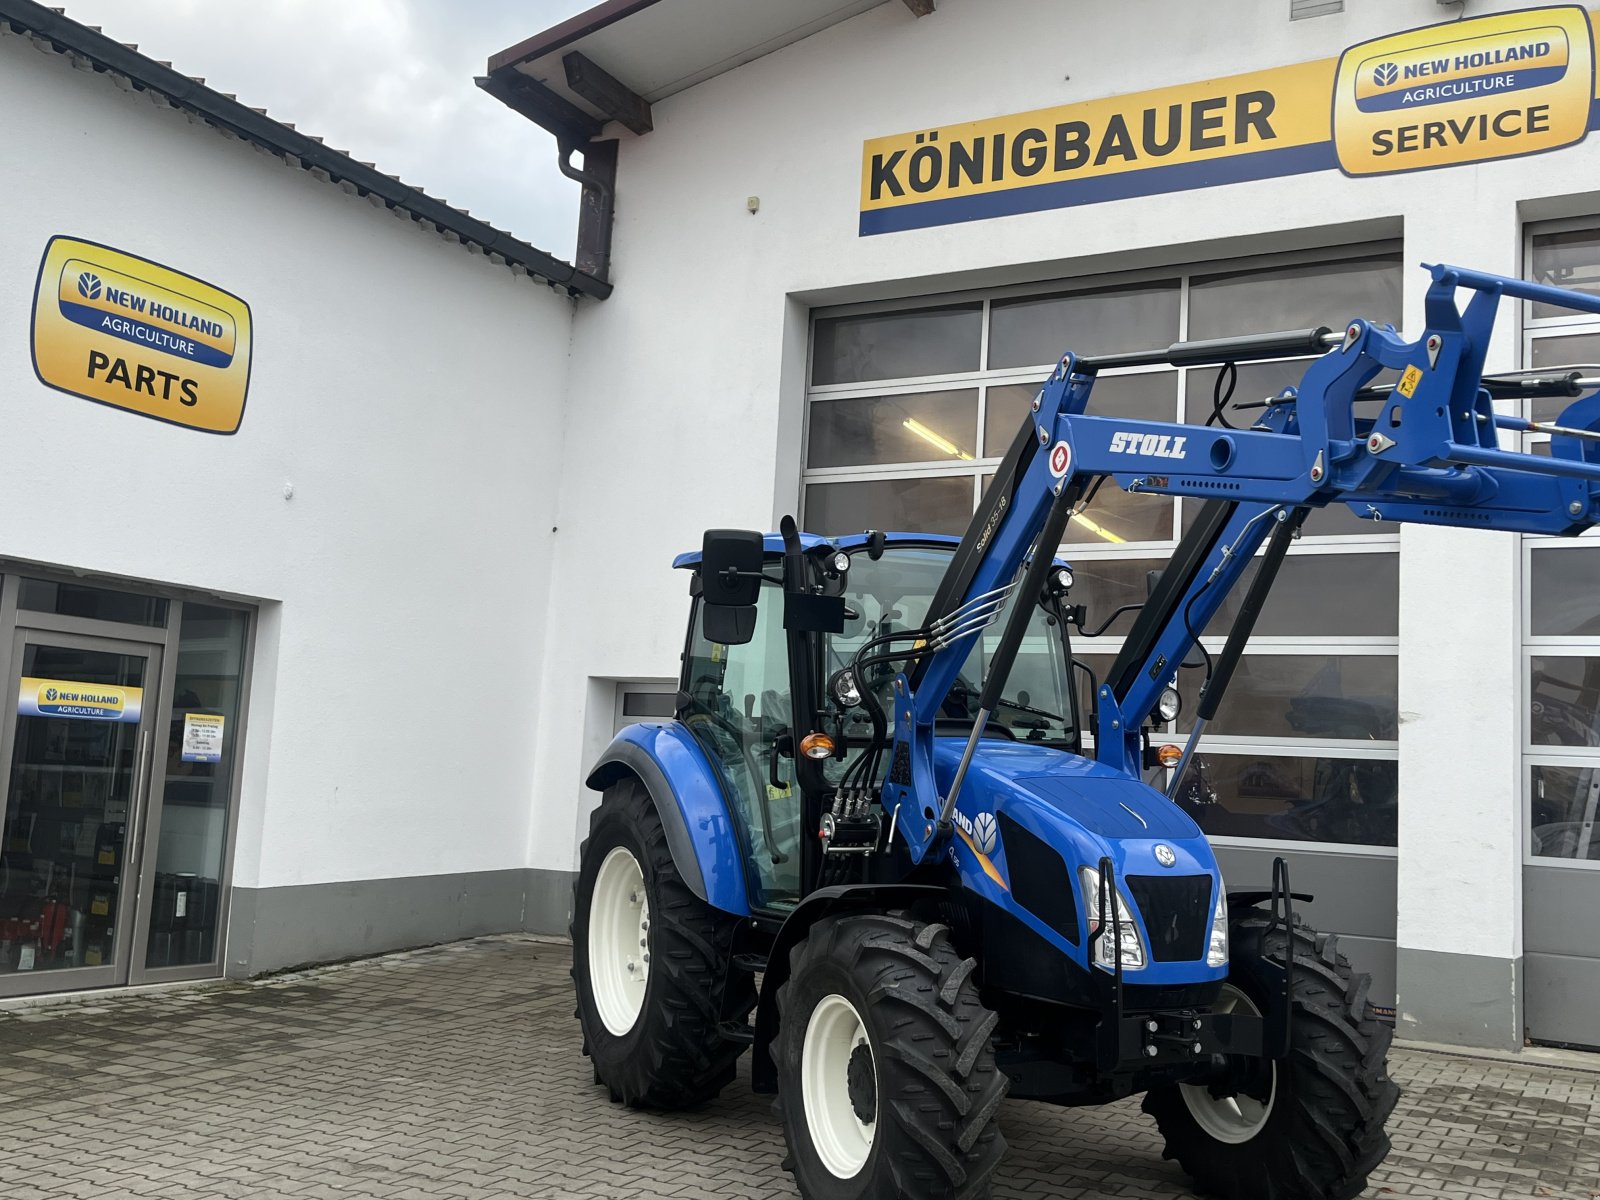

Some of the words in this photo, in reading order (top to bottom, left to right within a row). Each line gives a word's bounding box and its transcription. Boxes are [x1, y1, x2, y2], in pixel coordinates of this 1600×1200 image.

[1403, 58, 1450, 80] NEW
[1454, 41, 1550, 72] HOLLAND
[1402, 74, 1515, 104] AGRICULTURE
[870, 90, 1277, 200] KÖNIGBAUER
[1372, 104, 1550, 156] SERVICE
[106, 286, 146, 312] NEW
[149, 301, 223, 338] HOLLAND
[101, 316, 195, 355] AGRICULTURE
[87, 349, 199, 407] PARTS
[1109, 431, 1187, 459] STOLL
[57, 705, 104, 716] AGRICULTURE
[59, 691, 79, 702] NEW
[80, 693, 119, 705] HOLLAND
